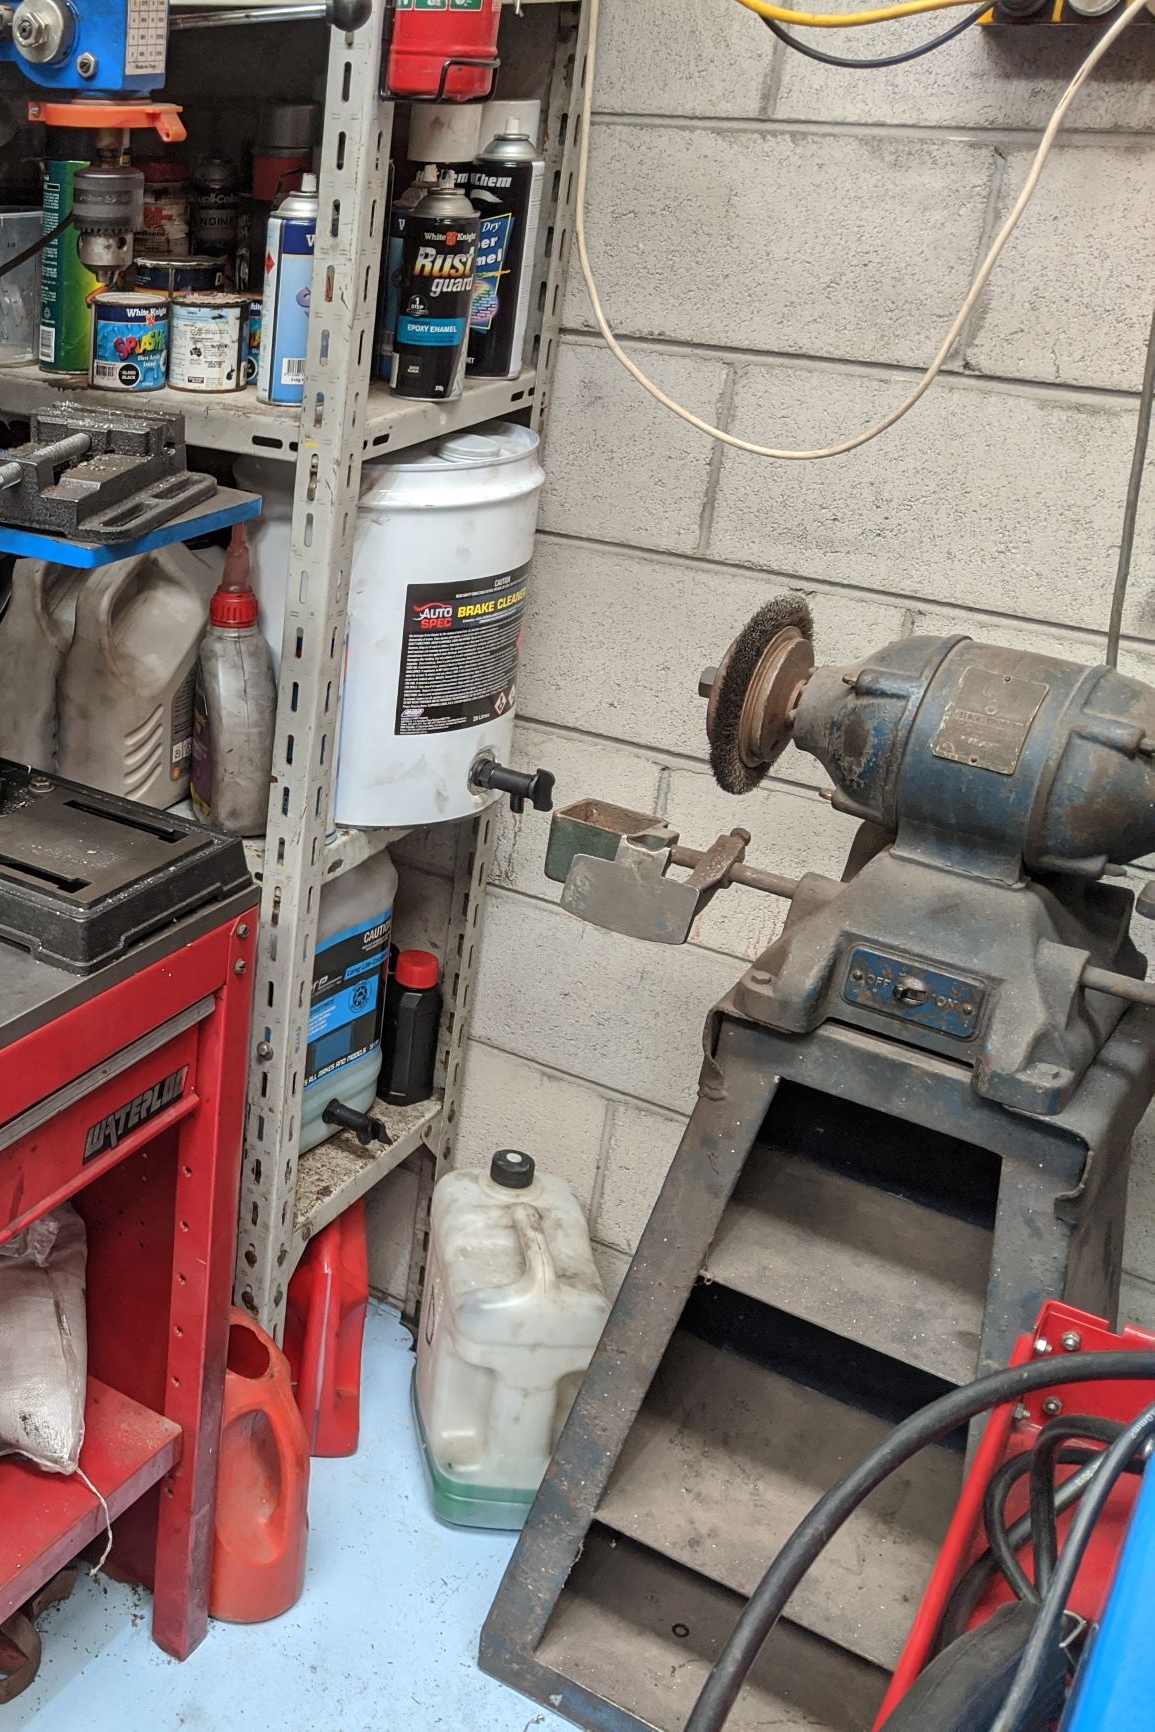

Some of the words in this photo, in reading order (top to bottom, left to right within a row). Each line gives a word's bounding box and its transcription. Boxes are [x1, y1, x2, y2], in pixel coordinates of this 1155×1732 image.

[482, 221, 500, 233] Dry
[424, 232, 446, 241] White
[457, 232, 477, 243] Knight
[413, 246, 475, 277] Rust
[430, 275, 473, 297] guard
[126, 308, 150, 317] White
[407, 323, 429, 333] EPOXY
[429, 325, 457, 333] ENAMEL
[421, 607, 453, 619] AUTO
[457, 601, 495, 618] BRAKE
[420, 617, 453, 629] SPEC
